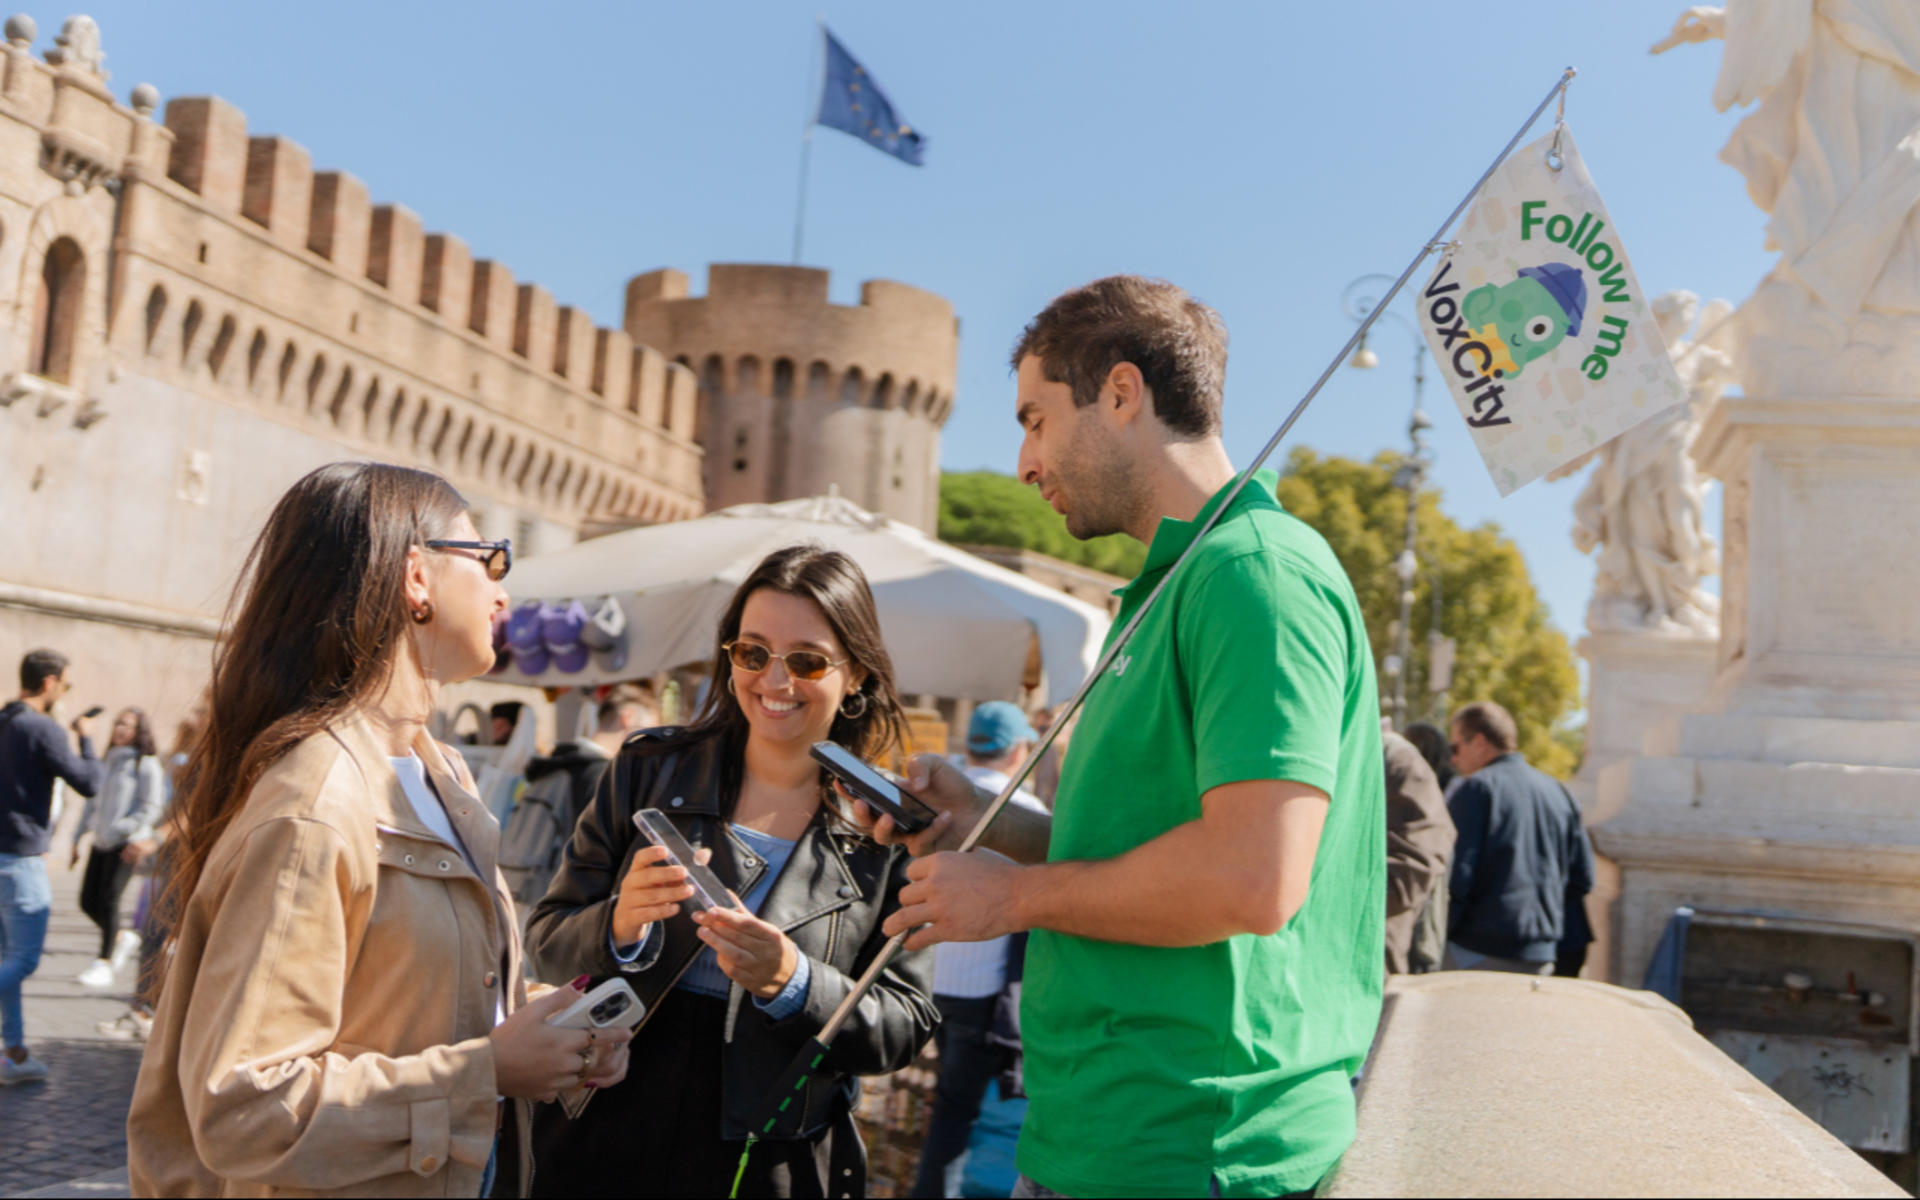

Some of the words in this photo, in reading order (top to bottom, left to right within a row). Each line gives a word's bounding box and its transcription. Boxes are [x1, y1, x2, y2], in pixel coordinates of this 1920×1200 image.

[1425, 261, 1512, 428] VoxCity
[1521, 200, 1631, 303] Follow
[1580, 315, 1629, 380] me
